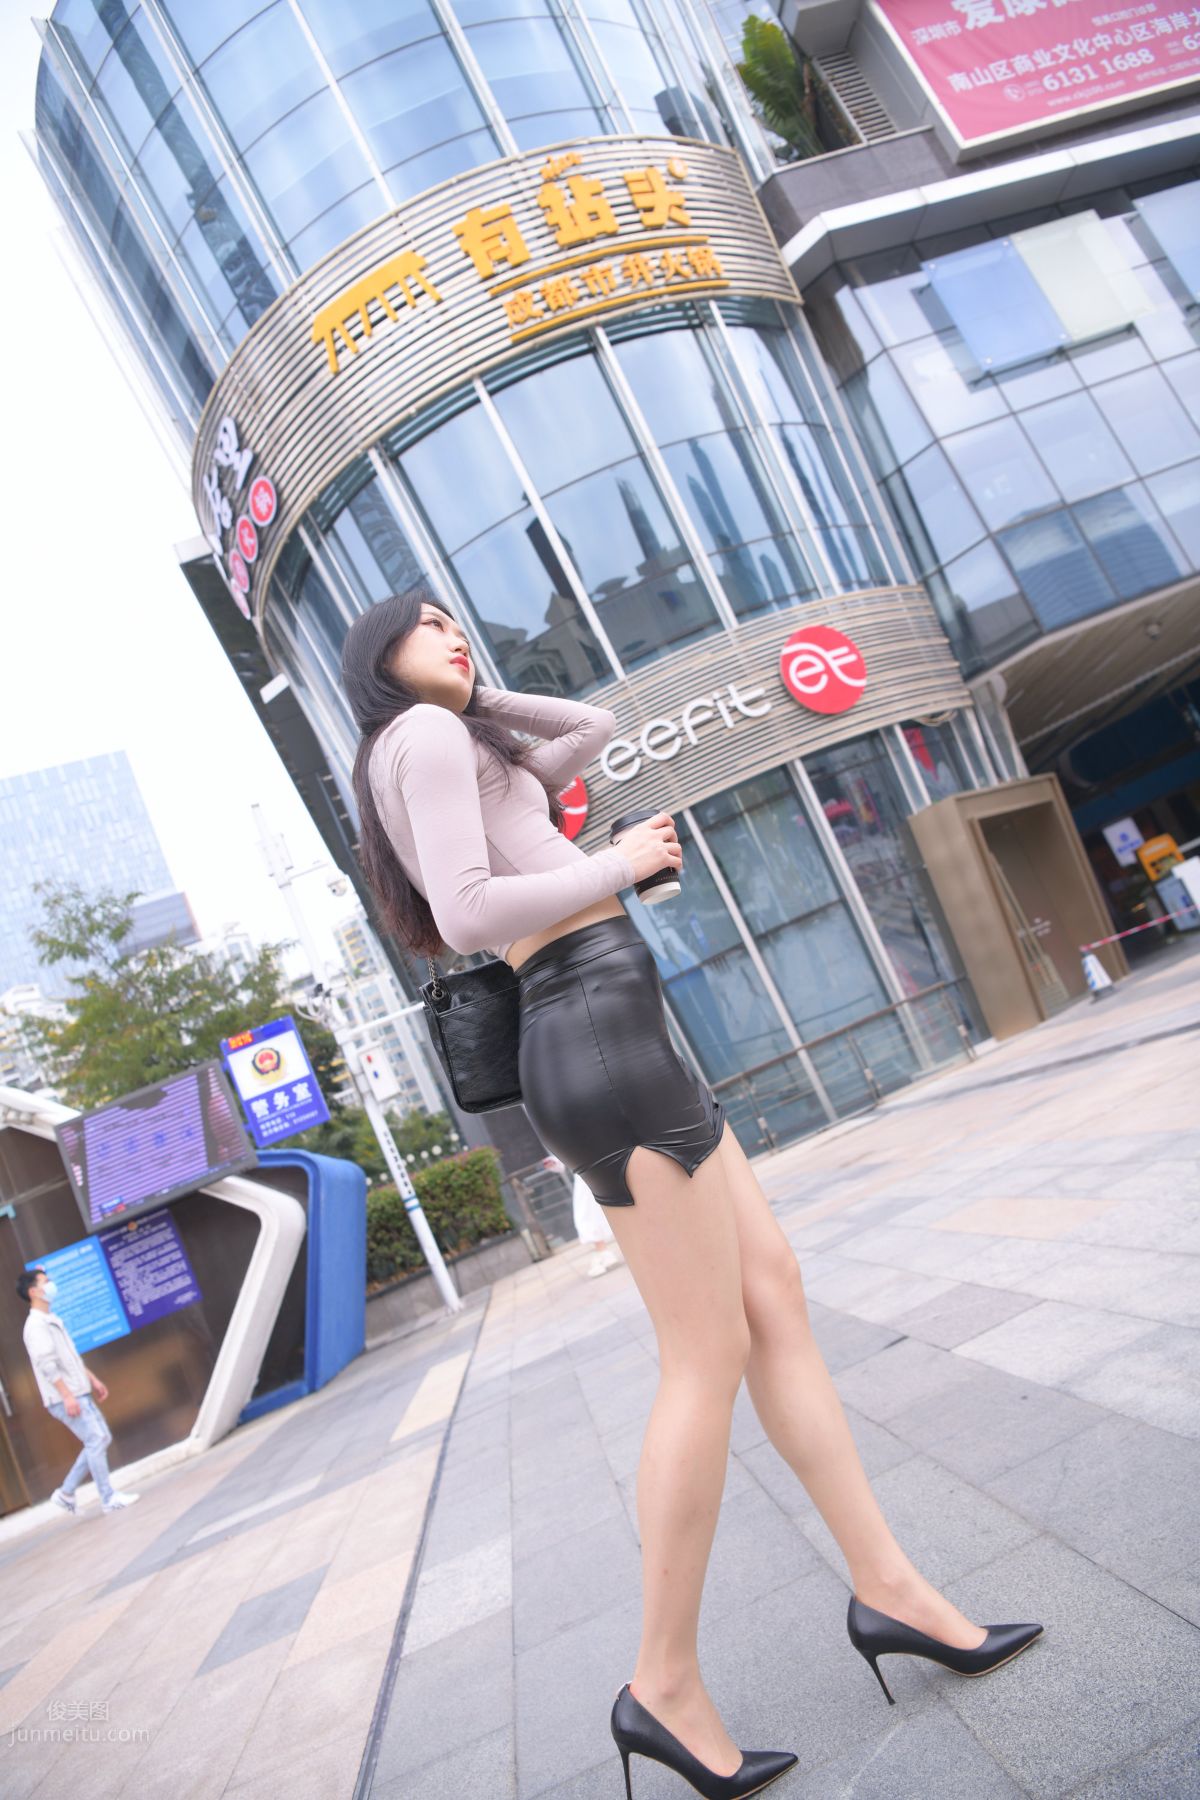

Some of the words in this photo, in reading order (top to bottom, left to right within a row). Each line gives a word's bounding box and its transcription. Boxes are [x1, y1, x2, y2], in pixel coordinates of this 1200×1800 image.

[1042, 63, 1099, 91] 6131
[1100, 48, 1155, 76] 1688
[503, 245, 725, 328] 成都市井火锅
[600, 684, 772, 781] eefit
